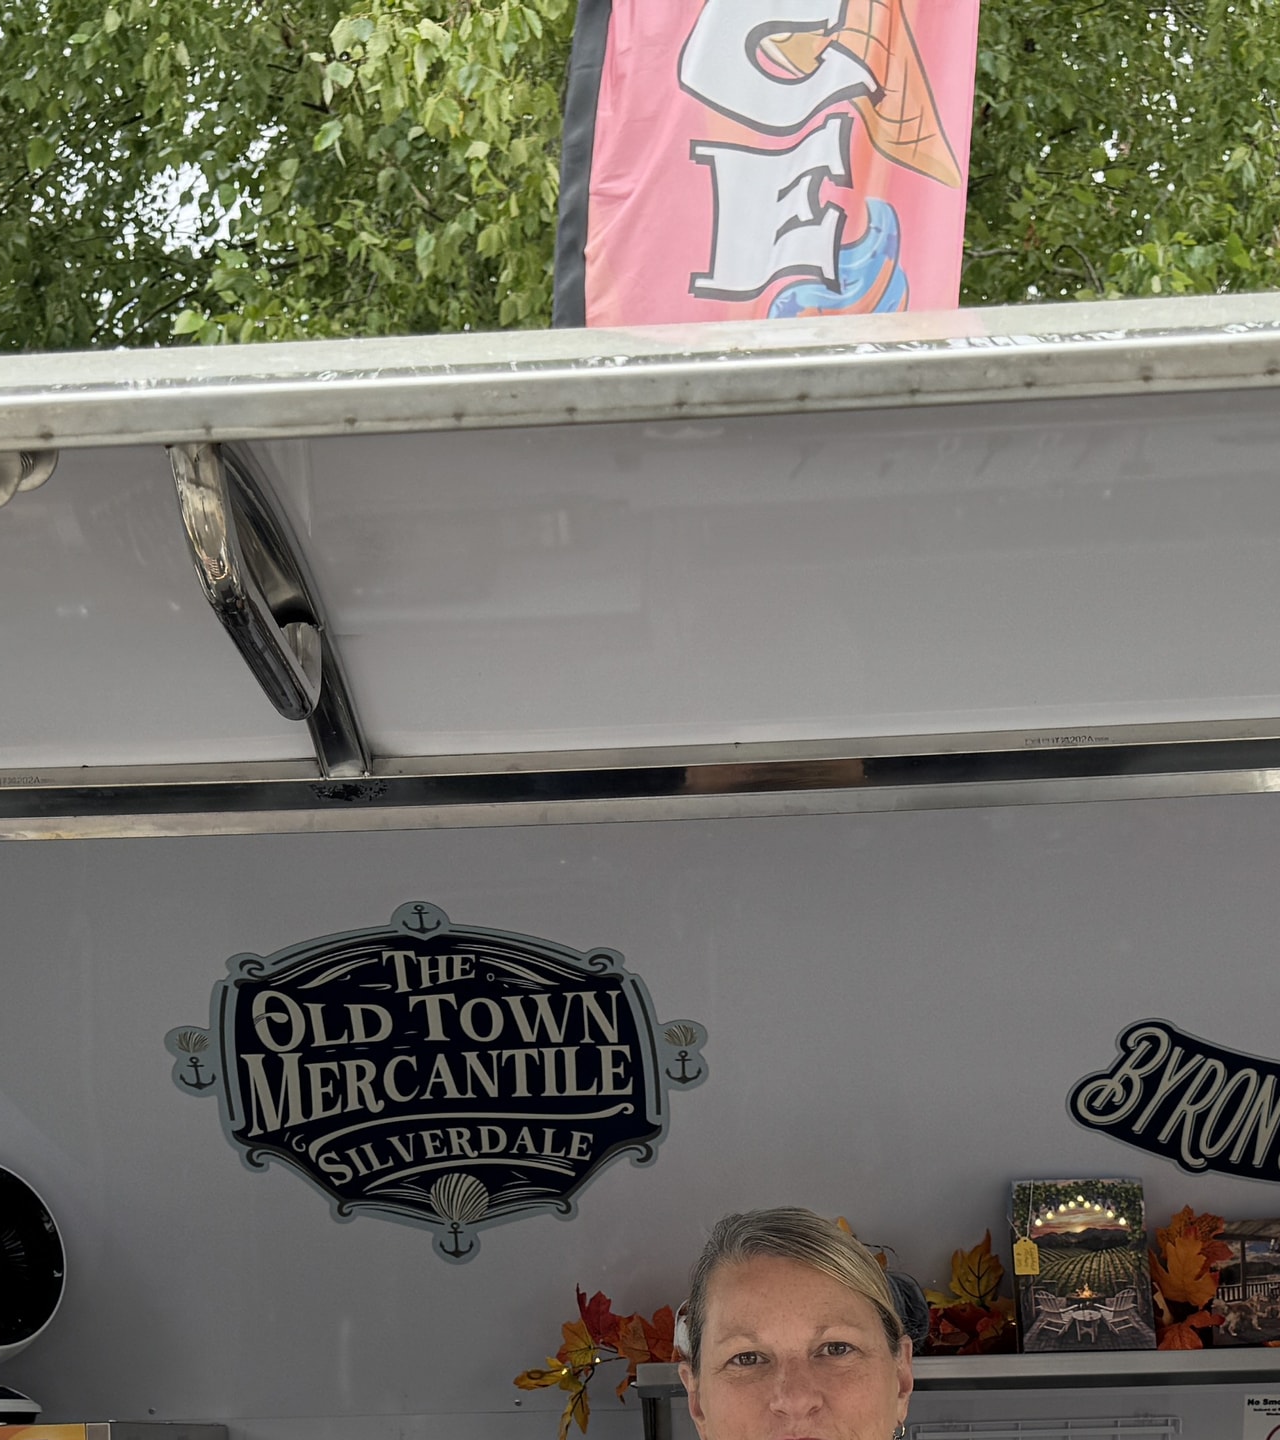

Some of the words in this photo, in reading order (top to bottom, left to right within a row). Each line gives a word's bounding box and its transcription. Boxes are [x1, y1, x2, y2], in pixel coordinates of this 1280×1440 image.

[382, 950, 476, 993] THE
[252, 990, 394, 1053] OLD
[408, 990, 622, 1043] TOWN
[241, 1044, 634, 1138] MERCANTILE
[318, 1125, 594, 1187] SILVERDALE
